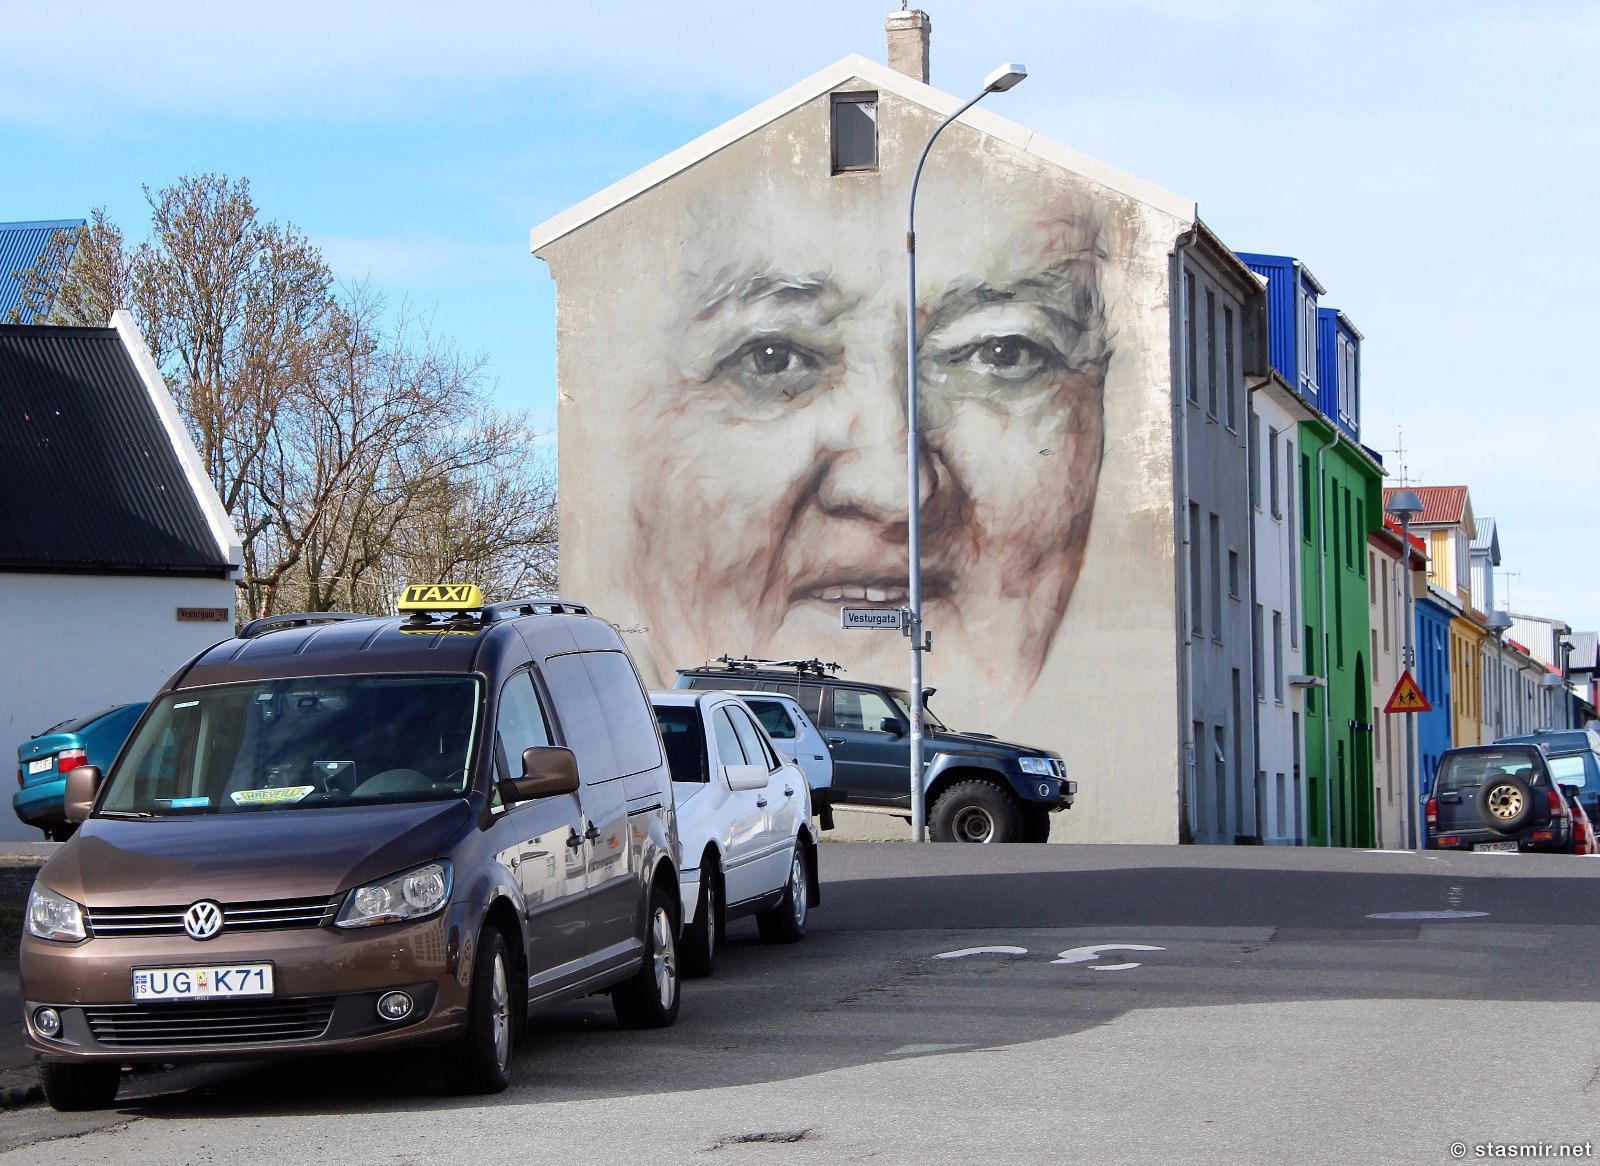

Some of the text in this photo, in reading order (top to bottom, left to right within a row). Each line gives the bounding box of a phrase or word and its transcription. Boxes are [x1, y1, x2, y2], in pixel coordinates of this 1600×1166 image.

[410, 586, 470, 601] TAXI
[181, 609, 215, 620] Vesturgata
[848, 613, 896, 624] Vesturgata
[136, 985, 147, 993] IS
[150, 972, 191, 994] UG
[214, 968, 265, 992] K71
